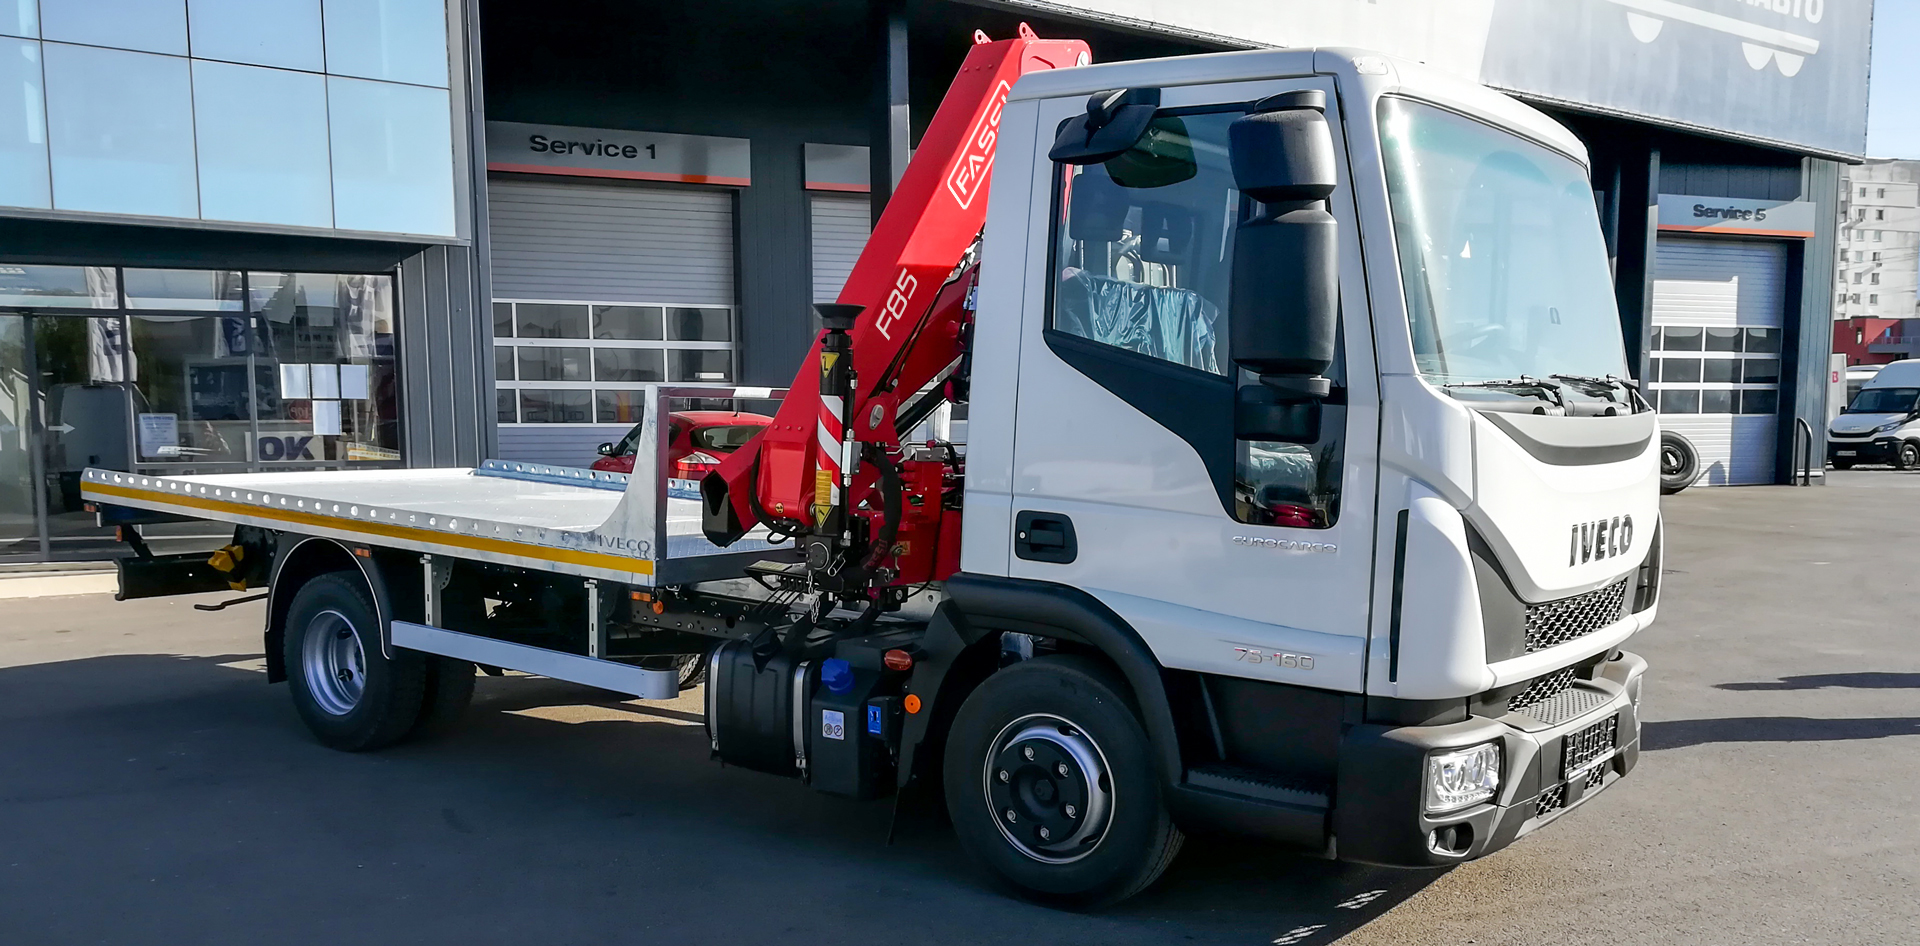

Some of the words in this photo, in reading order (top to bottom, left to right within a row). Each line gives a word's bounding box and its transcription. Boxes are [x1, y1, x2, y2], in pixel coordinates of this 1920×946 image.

[529, 134, 638, 159] Service
[645, 143, 656, 160] 1
[1693, 203, 1753, 221] Service
[1754, 207, 1767, 222] 5
[875, 267, 918, 341] F85
[599, 534, 650, 553] IVECO
[1232, 535, 1338, 554] EUROCARGO
[1568, 513, 1634, 568] IVECO
